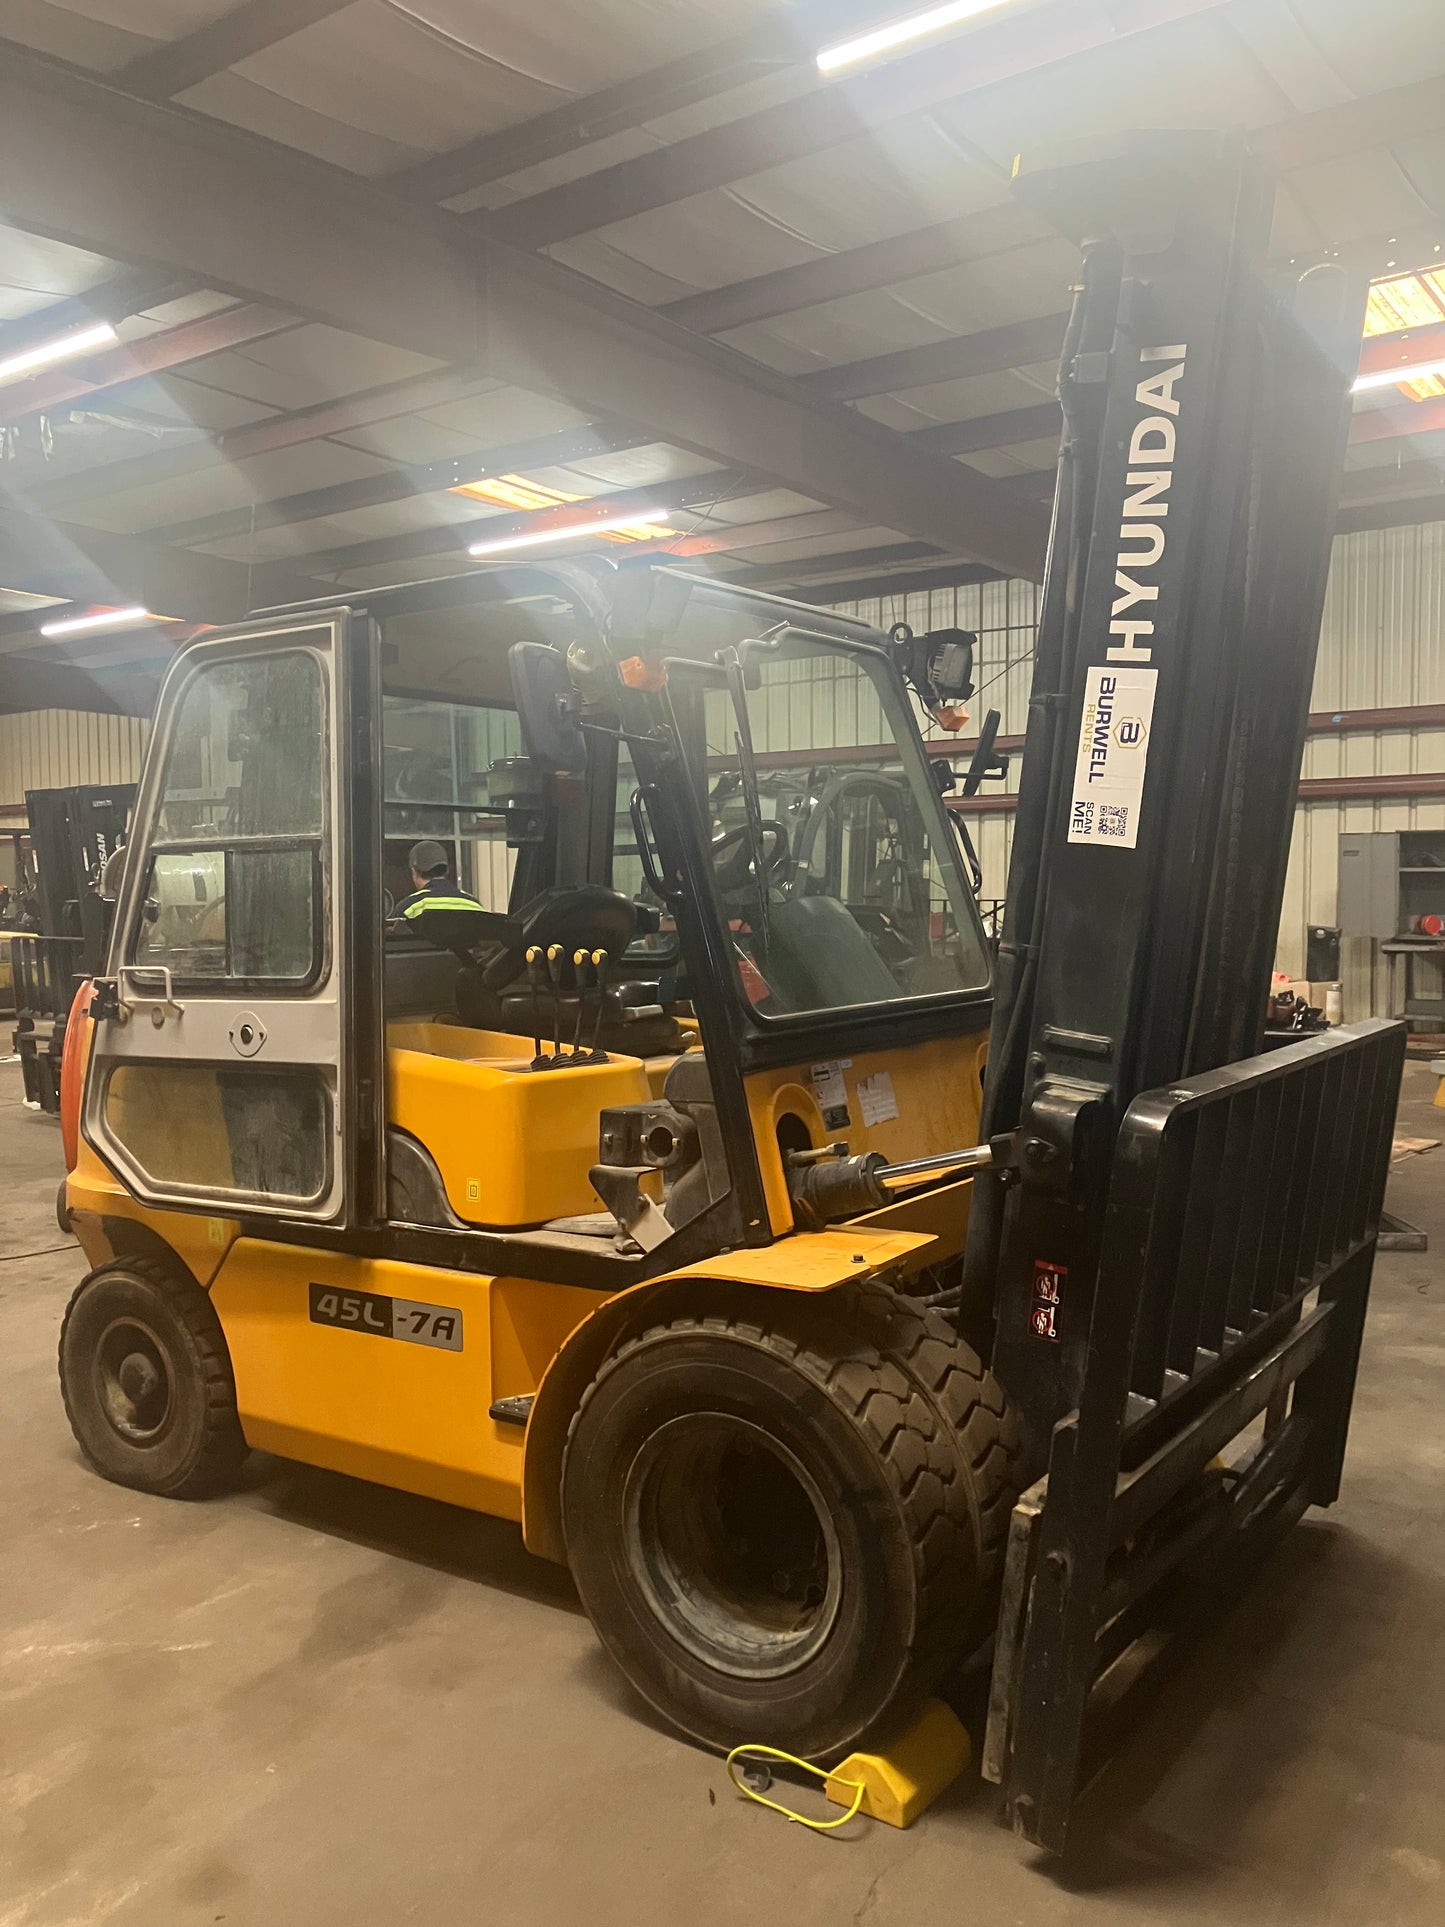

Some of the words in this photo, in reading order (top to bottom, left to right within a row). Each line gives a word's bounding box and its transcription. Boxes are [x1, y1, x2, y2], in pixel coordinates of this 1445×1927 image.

[1106, 344, 1188, 662] HYUNDAI
[1082, 704, 1096, 753] RENTS
[1088, 677, 1116, 783] BURWELL
[1072, 801, 1086, 833] ME!
[1083, 802, 1096, 835] SCAN
